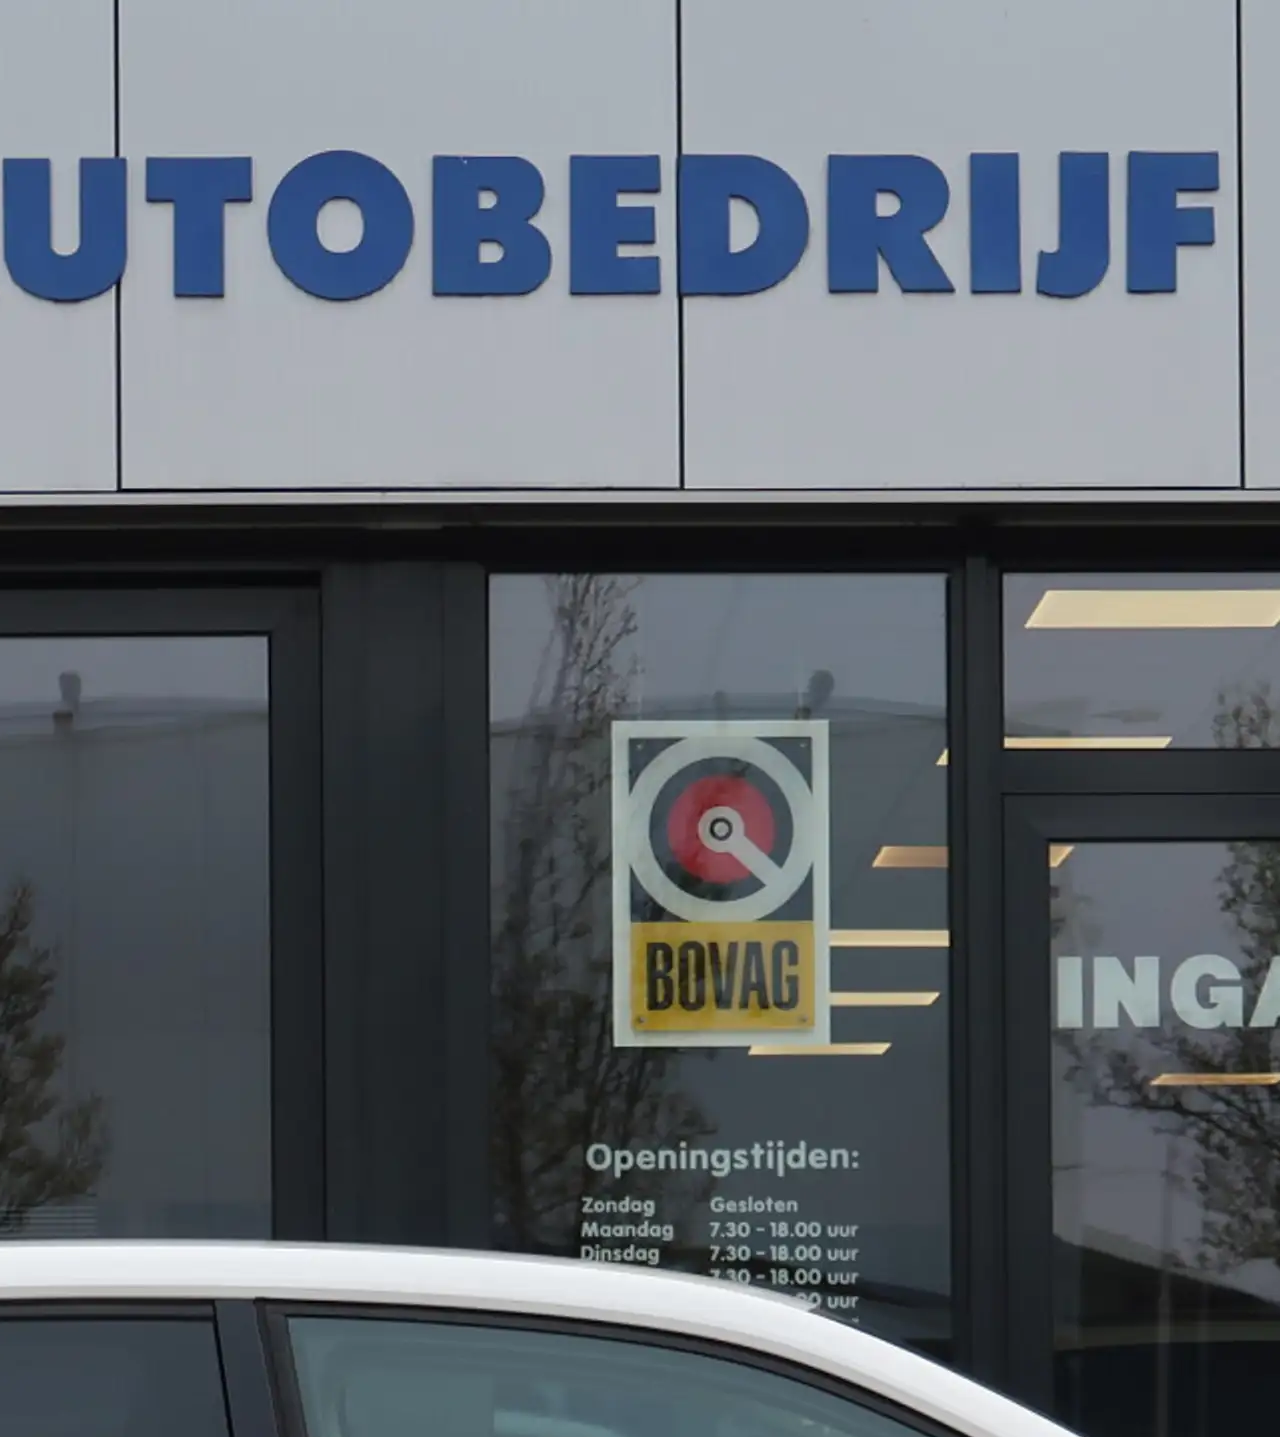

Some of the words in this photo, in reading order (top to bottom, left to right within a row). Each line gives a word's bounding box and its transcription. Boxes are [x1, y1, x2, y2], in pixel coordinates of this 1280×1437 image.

[645, 940, 800, 1012] BOVAG
[585, 1140, 860, 1178] Openingstijden:
[581, 1196, 656, 1218] Zondag
[709, 1196, 800, 1214] Gesloten
[581, 1220, 675, 1242] Maandag
[709, 1222, 752, 1239] 7.30
[769, 1222, 822, 1239] 18.00
[827, 1226, 860, 1239] uur
[581, 1245, 660, 1265] Dinsdag
[709, 1246, 752, 1263] 7.30
[769, 1245, 822, 1263] 18.00
[827, 1249, 860, 1263] uur
[709, 1269, 752, 1286] 730
[770, 1269, 822, 1286] 18.00
[827, 1273, 860, 1286] uur
[827, 1296, 860, 1310] uur
